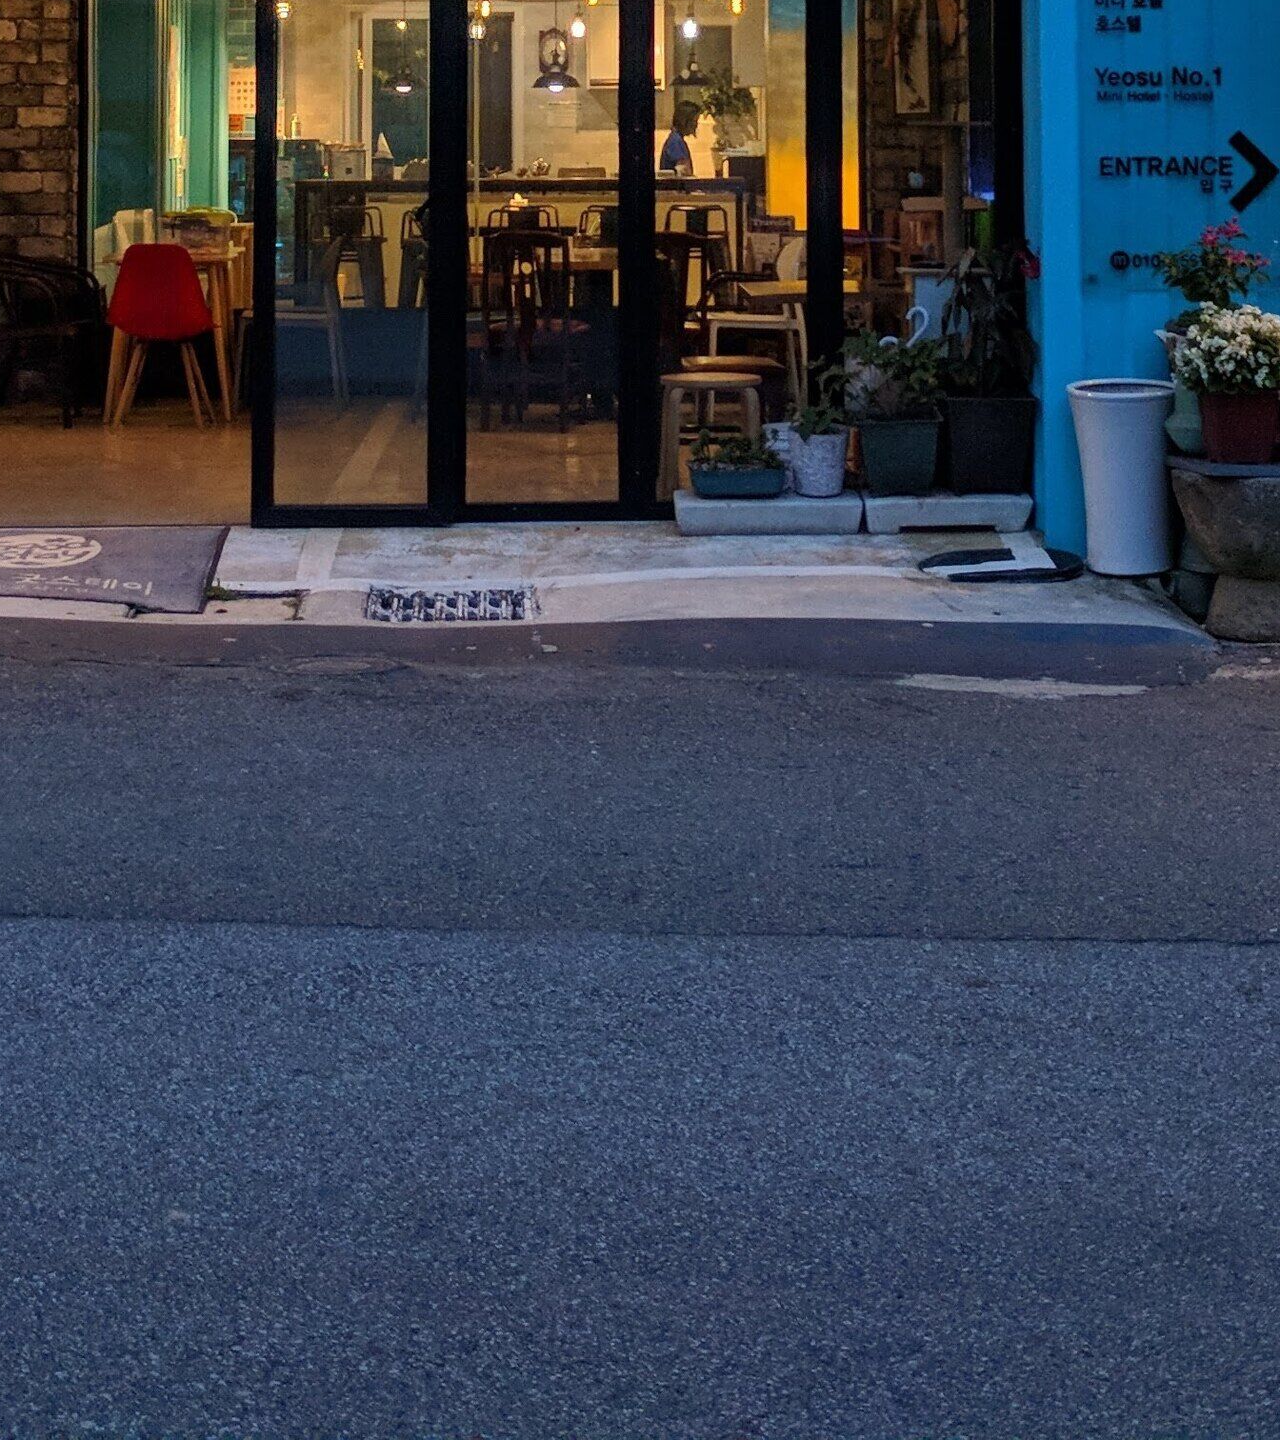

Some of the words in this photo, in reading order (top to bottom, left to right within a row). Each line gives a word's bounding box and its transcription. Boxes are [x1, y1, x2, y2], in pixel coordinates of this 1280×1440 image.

[1095, 15, 1142, 32] 호스텔
[1094, 66, 1163, 86] Yeosu
[1172, 66, 1222, 87] No.1
[1099, 156, 1233, 177] ENTRANCE
